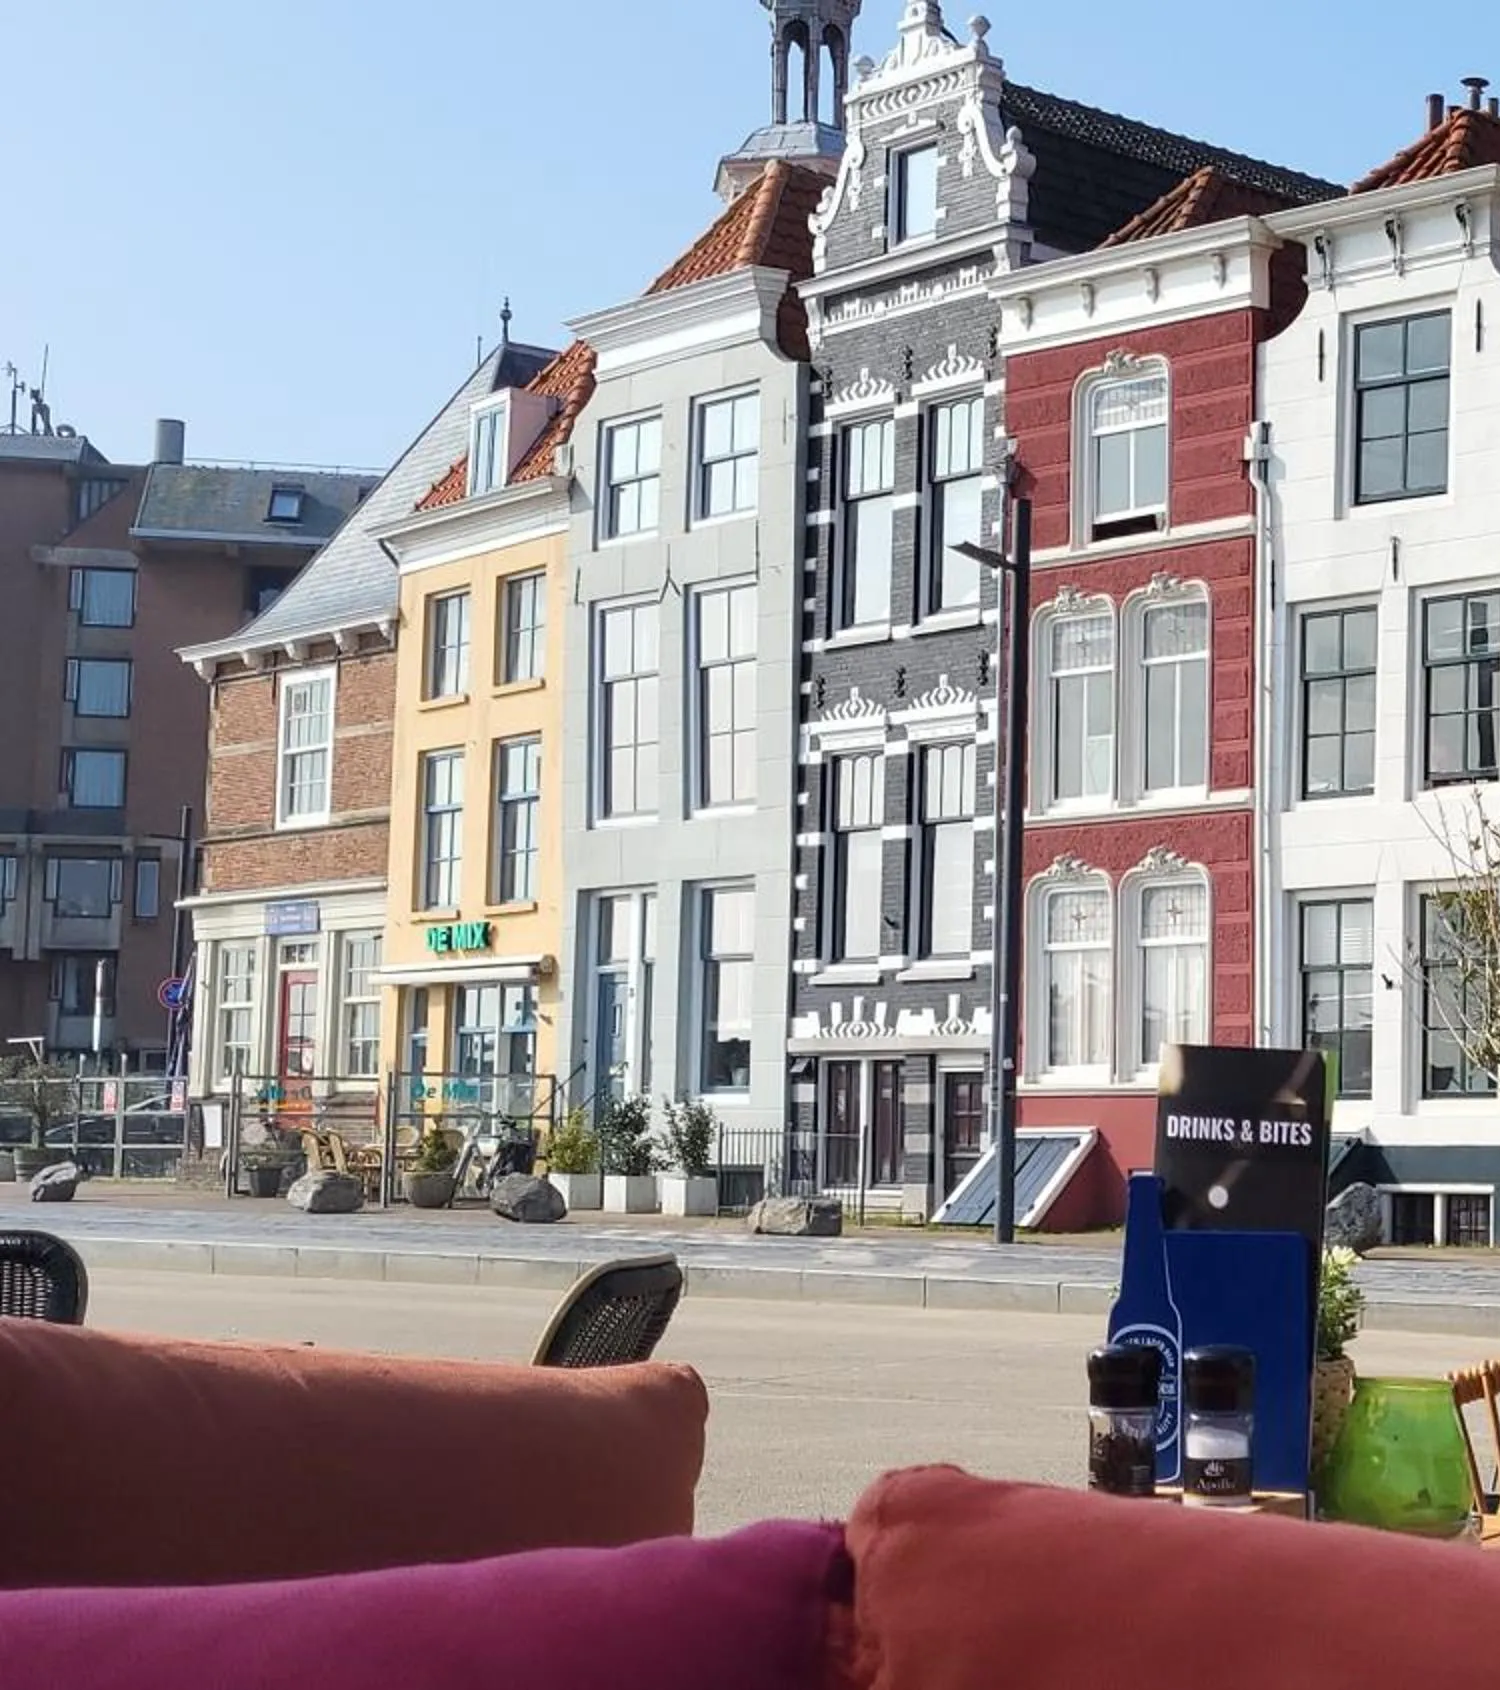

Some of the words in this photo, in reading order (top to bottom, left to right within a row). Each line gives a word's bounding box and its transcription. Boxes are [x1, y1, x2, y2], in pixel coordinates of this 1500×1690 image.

[425, 926, 450, 951] DE
[452, 922, 489, 950] MIX
[1167, 1115, 1235, 1141] DRINKS
[1241, 1119, 1253, 1142] &
[1259, 1120, 1312, 1145] BITES
